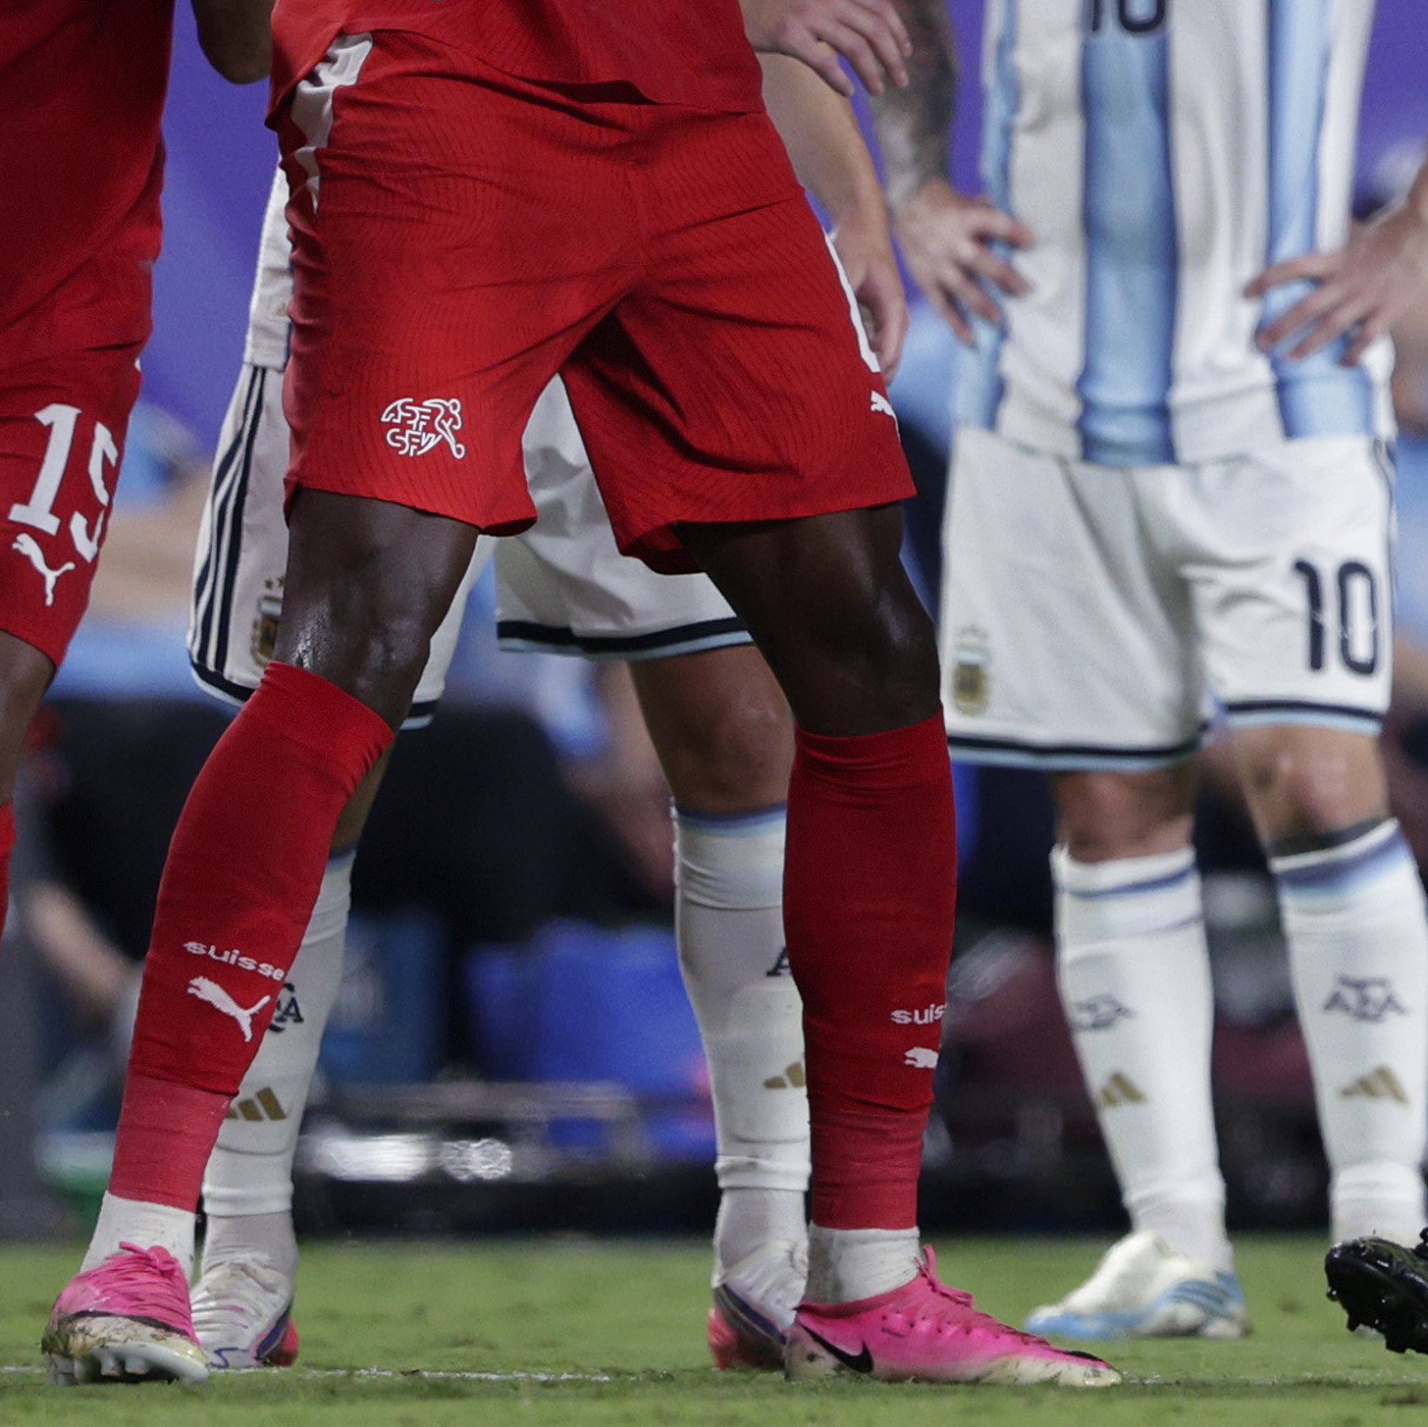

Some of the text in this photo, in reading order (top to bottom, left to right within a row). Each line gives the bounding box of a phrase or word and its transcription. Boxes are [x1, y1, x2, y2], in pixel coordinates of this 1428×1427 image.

[7, 402, 118, 563] 15
[1292, 558, 1379, 676] 10
[183, 941, 285, 981] suisse
